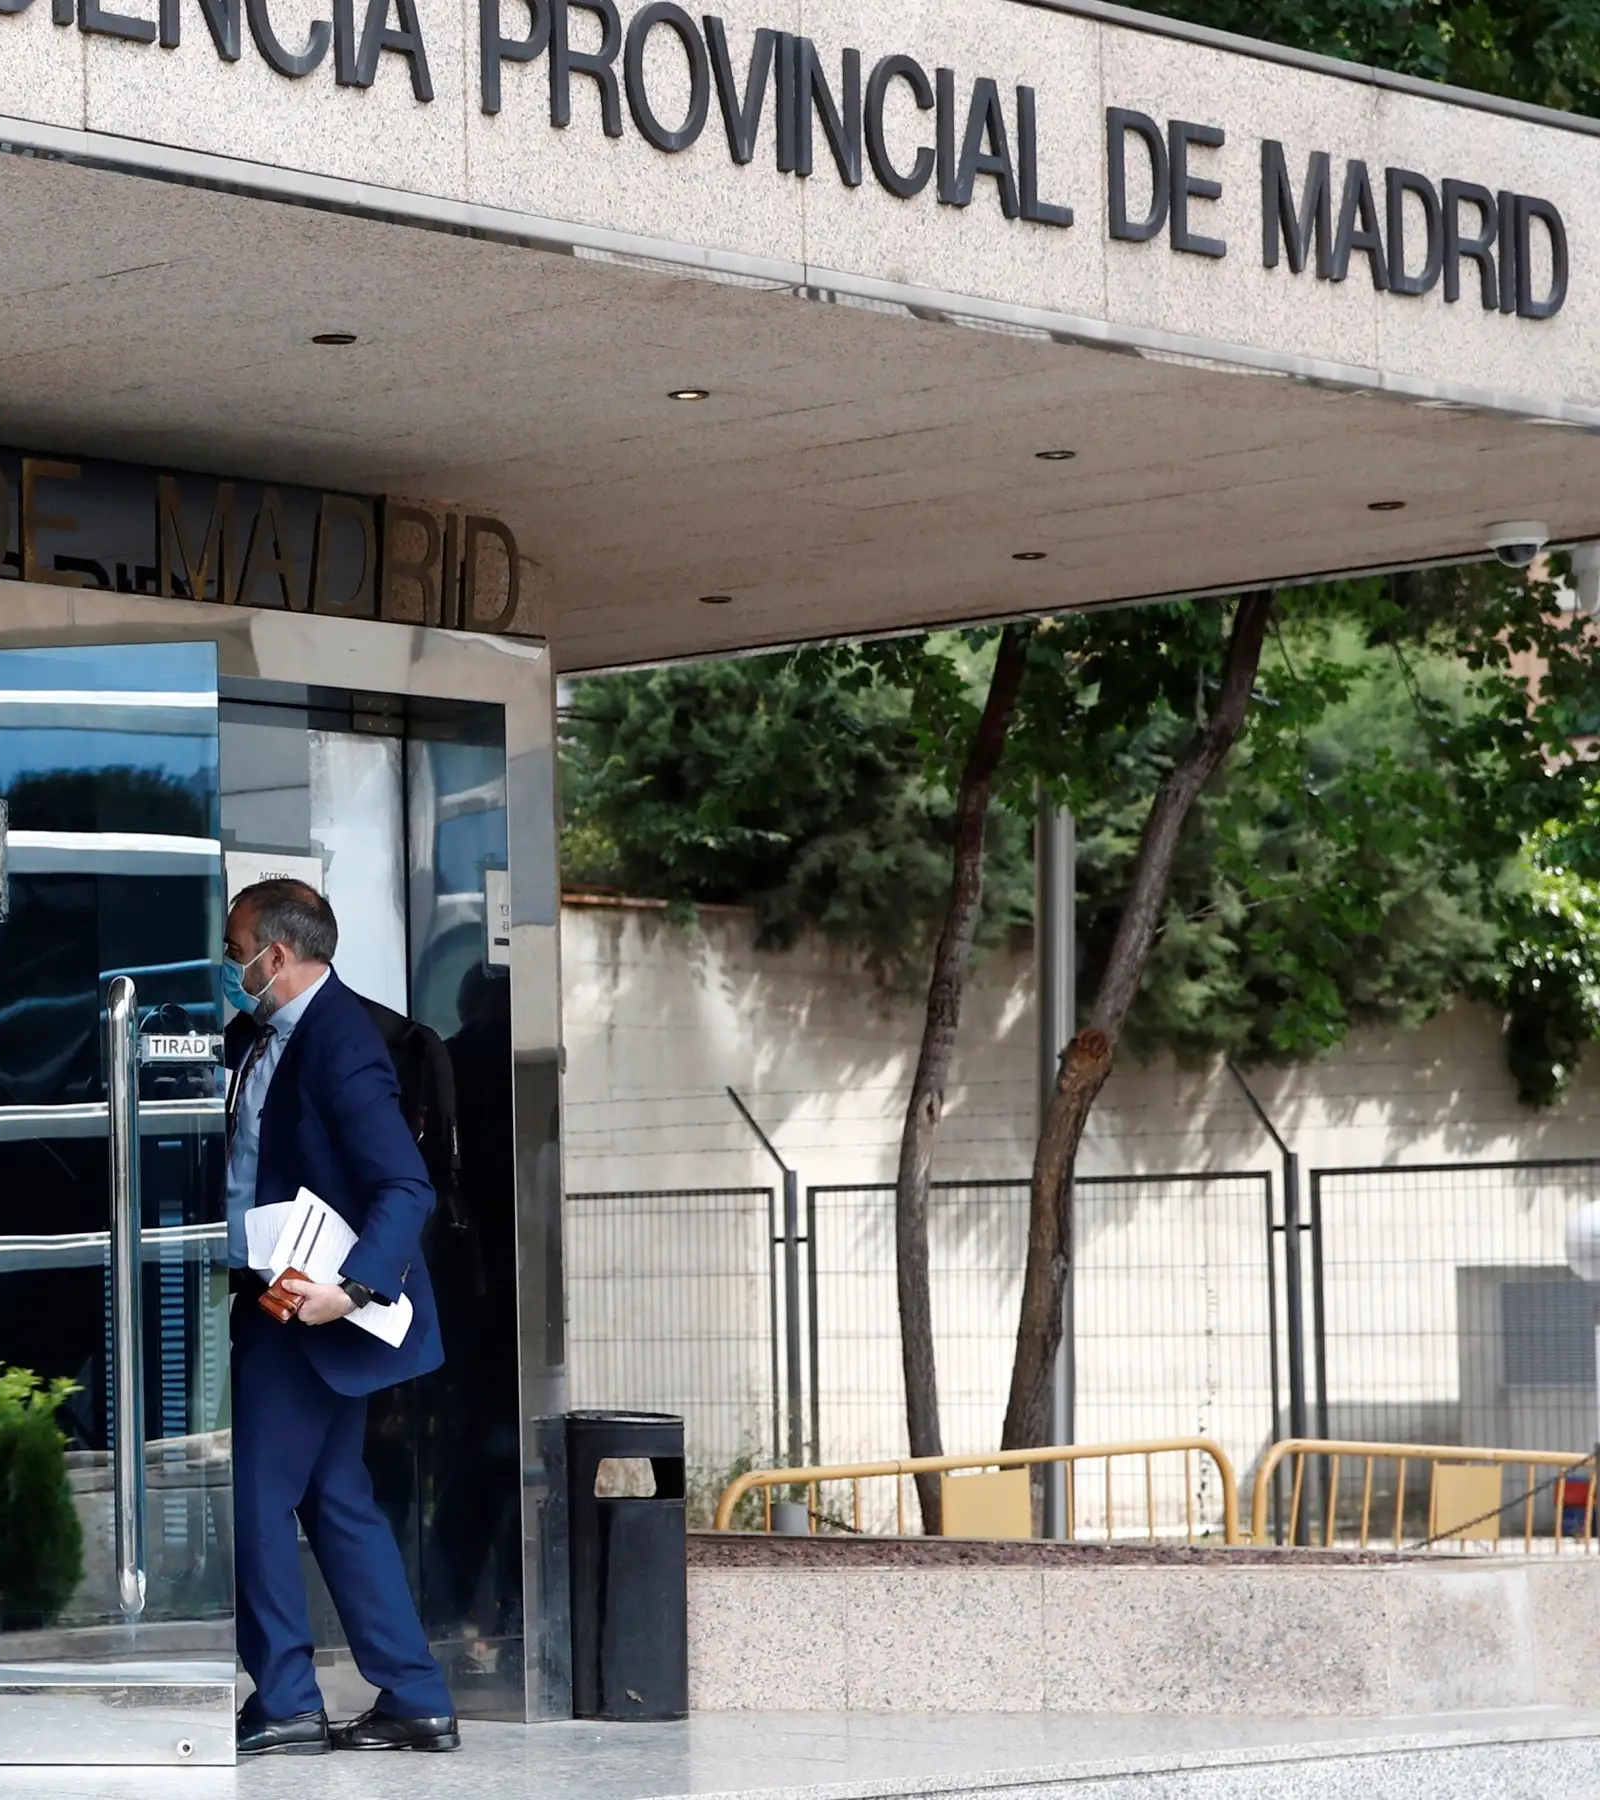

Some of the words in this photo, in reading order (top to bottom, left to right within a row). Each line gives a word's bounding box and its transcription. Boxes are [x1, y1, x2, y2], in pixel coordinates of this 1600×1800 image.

[481, 0, 1073, 227] PROVINCIAL
[1106, 106, 1226, 258] DE
[1260, 139, 1569, 320] MADRID
[156, 475, 519, 631] MADRID
[151, 1039, 206, 1054] TIRAD
